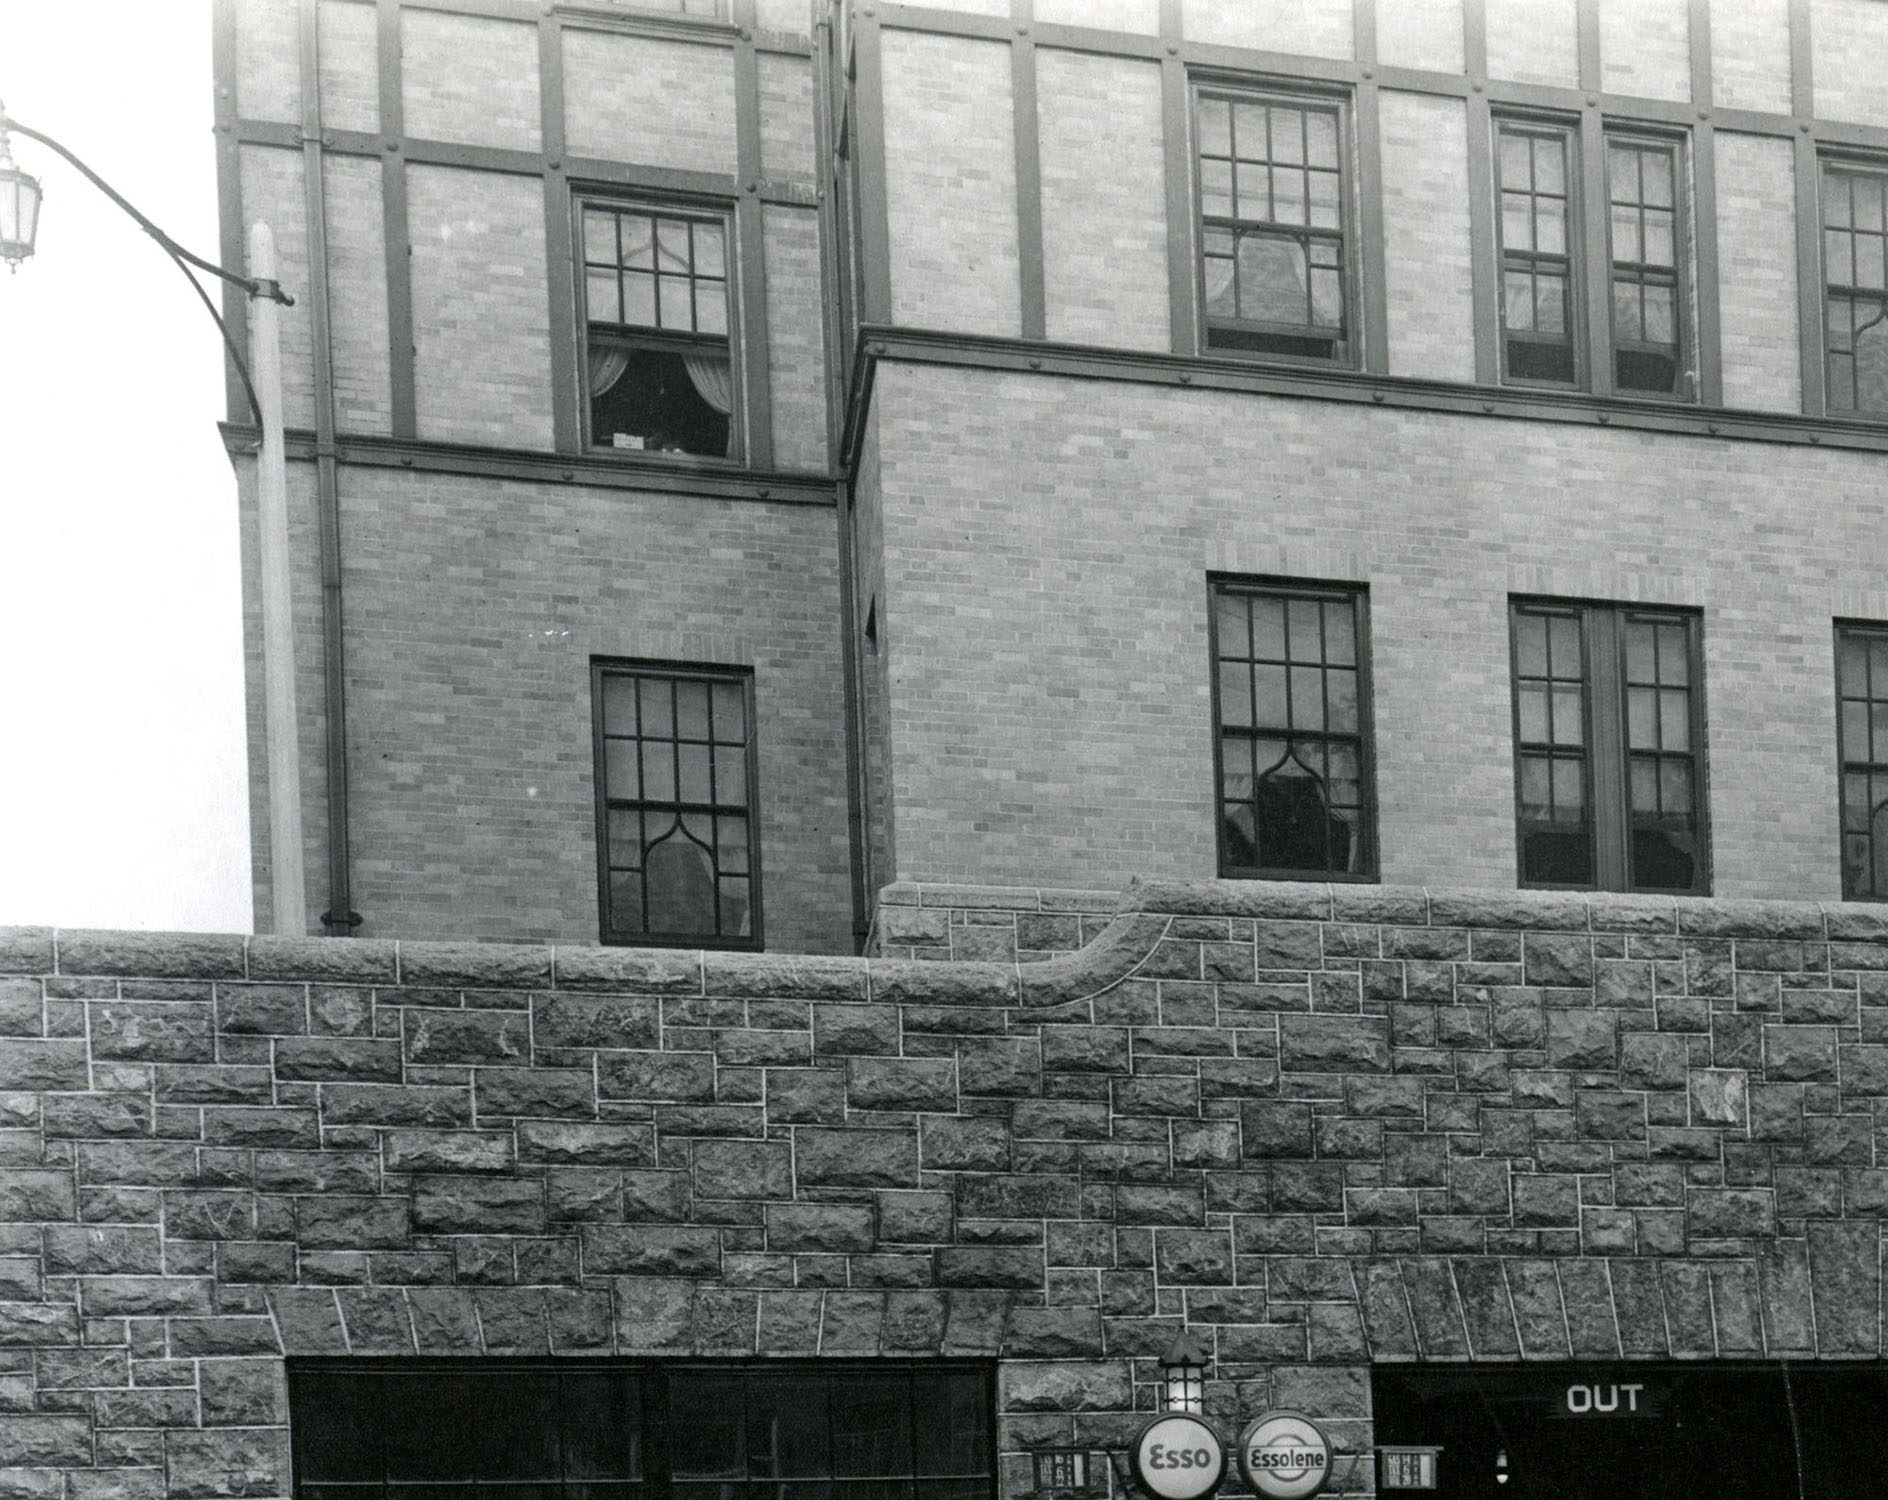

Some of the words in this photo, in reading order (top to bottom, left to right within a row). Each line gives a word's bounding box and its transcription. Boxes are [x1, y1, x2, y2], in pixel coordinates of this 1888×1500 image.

[1566, 1384, 1643, 1412] OUT
[1149, 1443, 1211, 1470] Esso
[1250, 1449, 1325, 1468] Essolene
